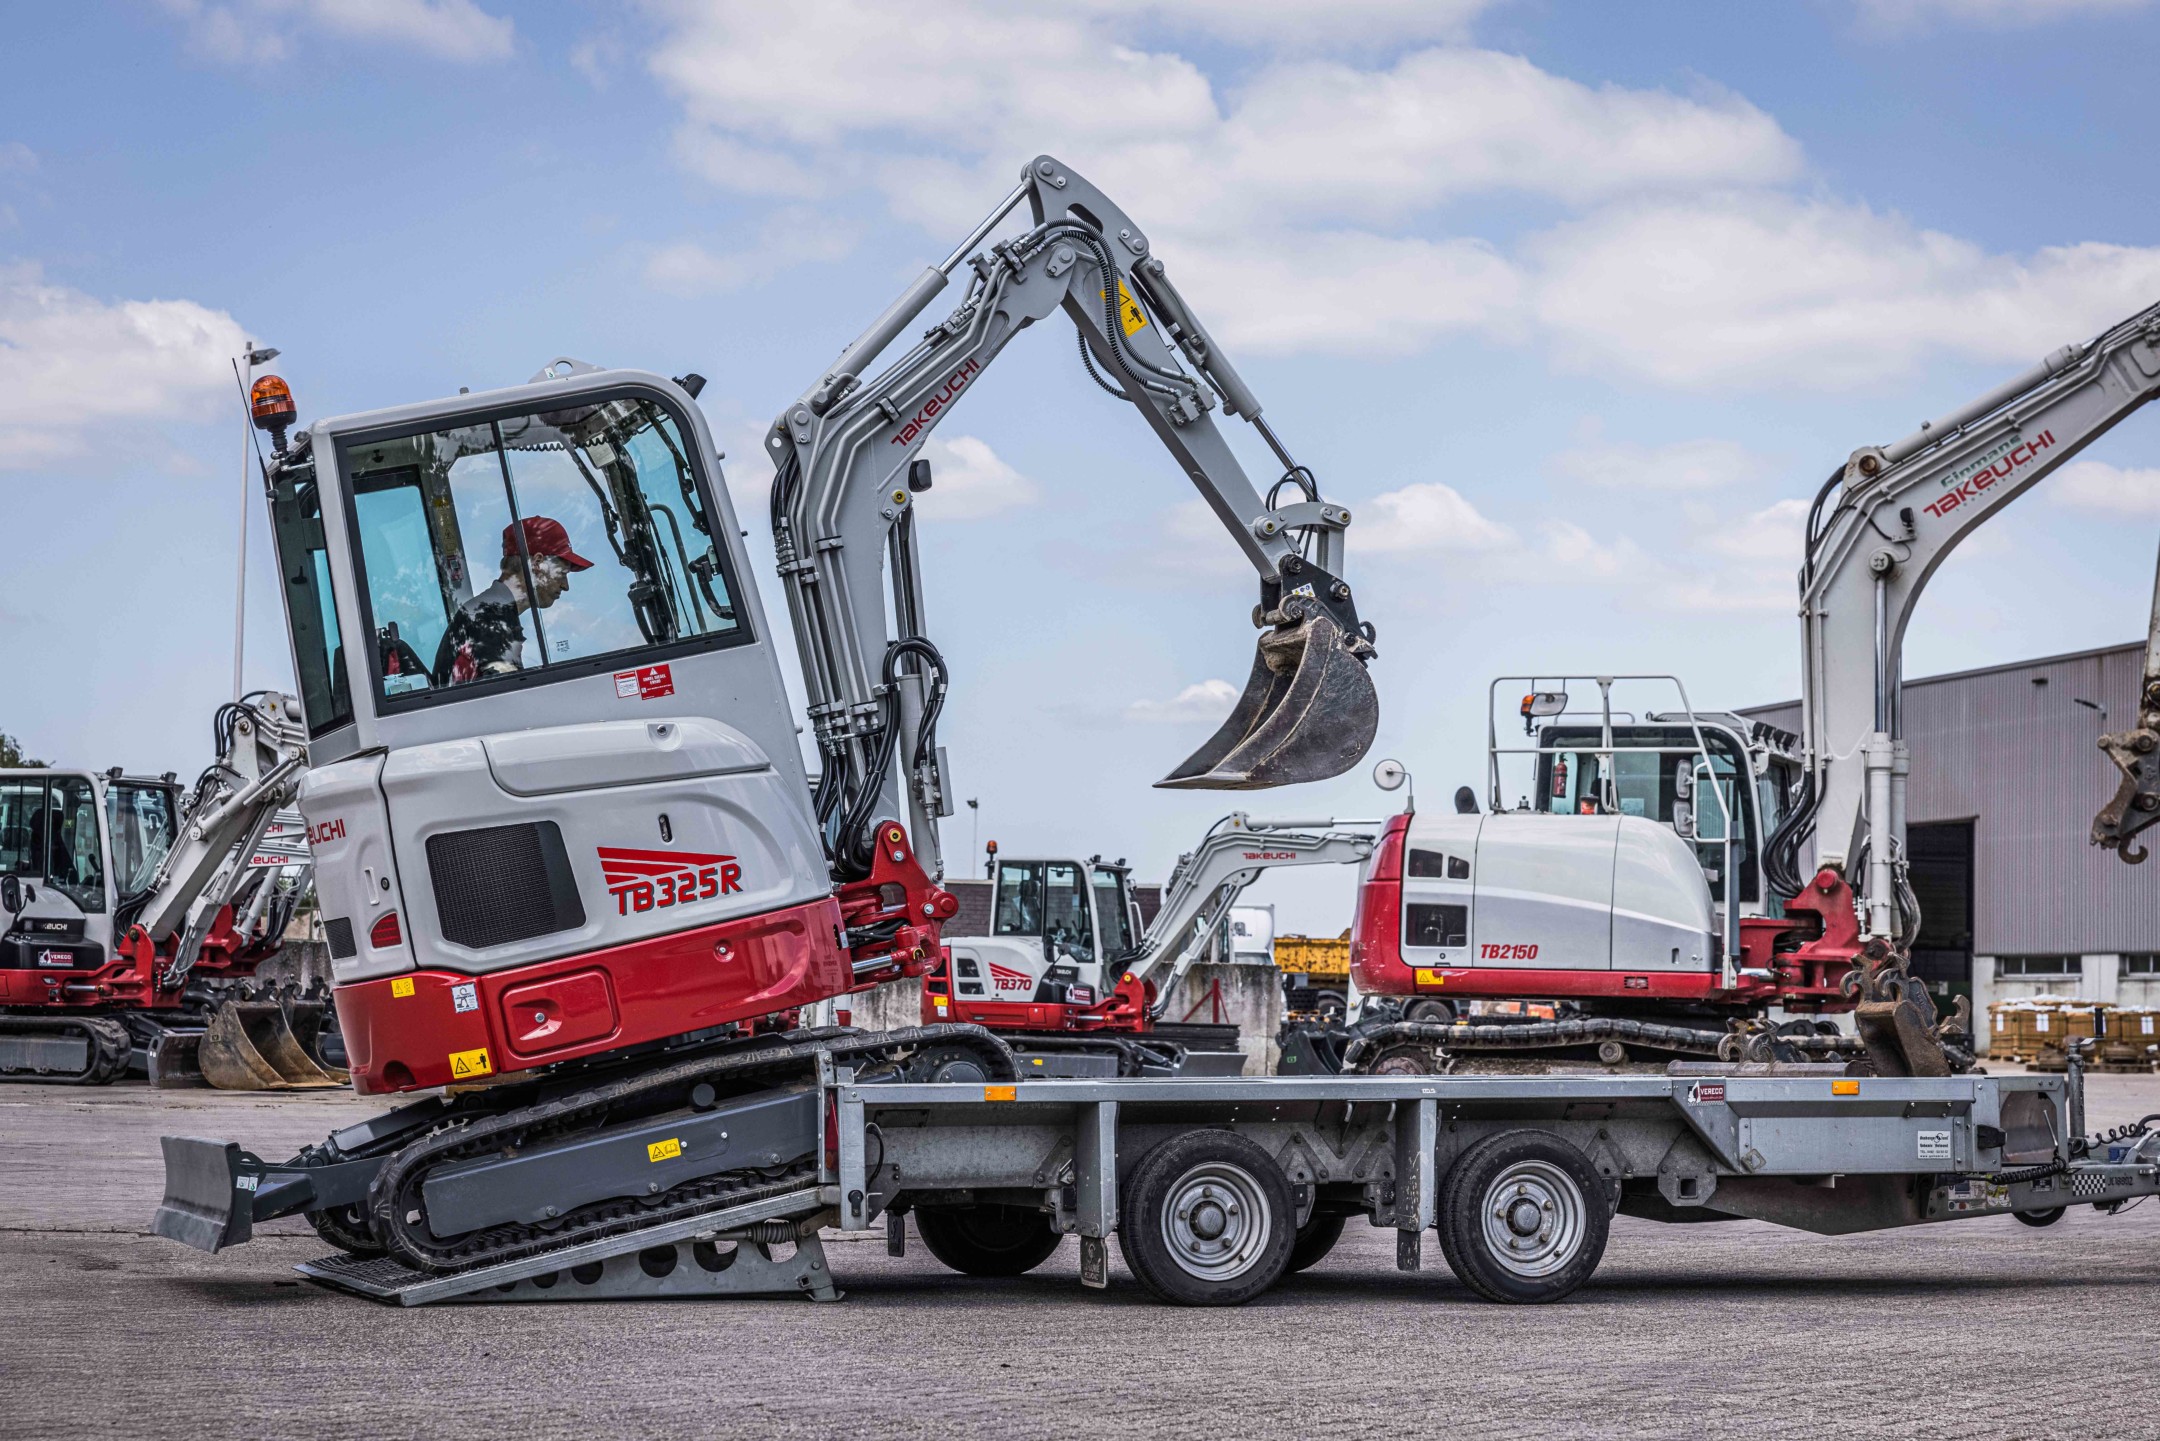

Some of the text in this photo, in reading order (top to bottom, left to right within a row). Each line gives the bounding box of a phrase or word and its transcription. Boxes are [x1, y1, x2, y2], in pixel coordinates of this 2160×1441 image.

[609, 863, 743, 916] TB325R
[1480, 944, 1539, 960] TB2150
[994, 978, 1032, 991] TB370
